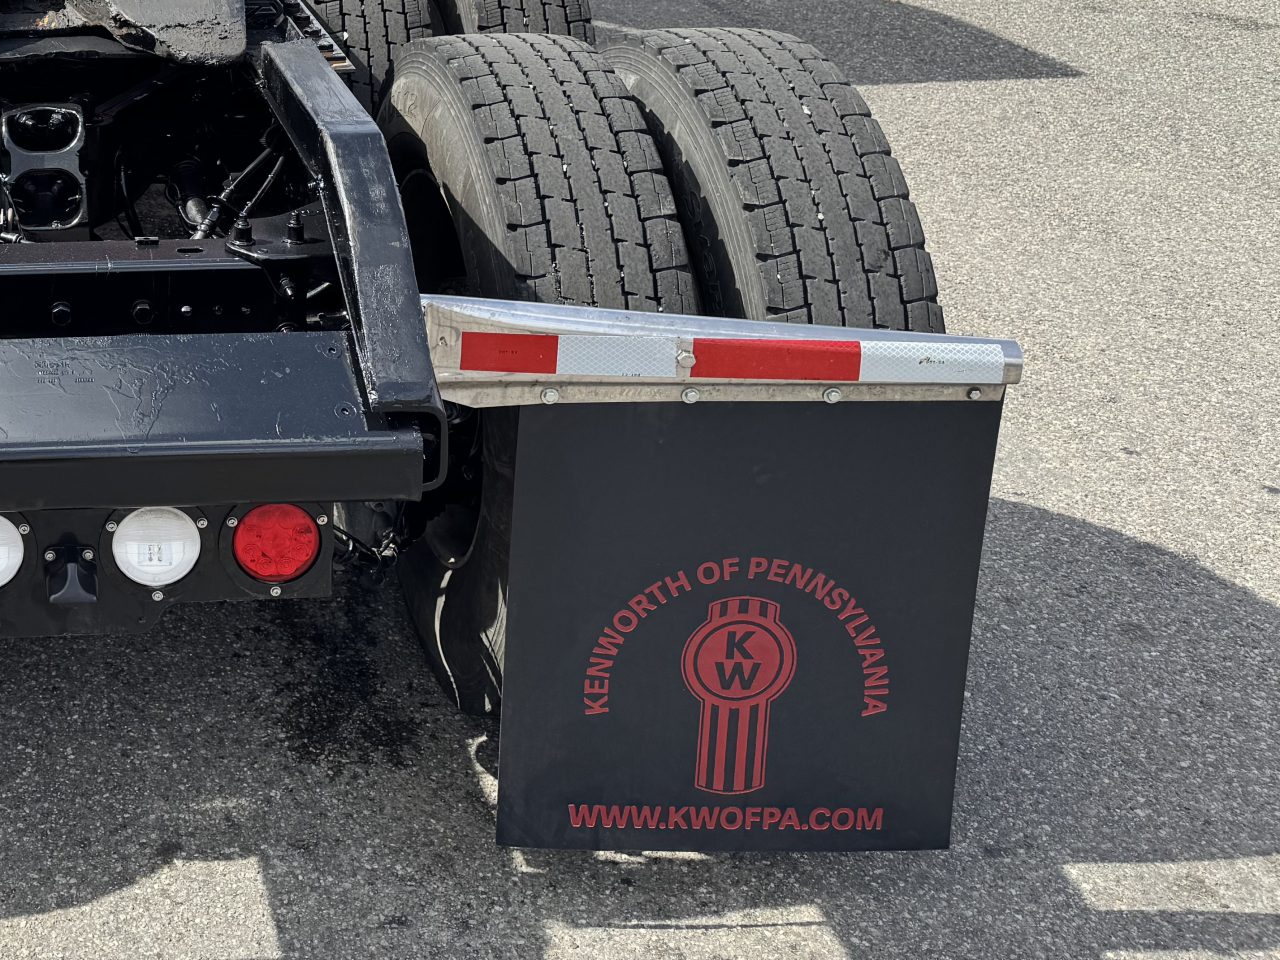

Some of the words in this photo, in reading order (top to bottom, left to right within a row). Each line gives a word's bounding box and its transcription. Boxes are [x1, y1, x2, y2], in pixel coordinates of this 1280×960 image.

[584, 571, 692, 716] KENWORTH
[697, 558, 740, 585] OF
[748, 557, 890, 717] PENNSYLVANIA
[568, 804, 884, 831] WWW.KWOFPA.COM
